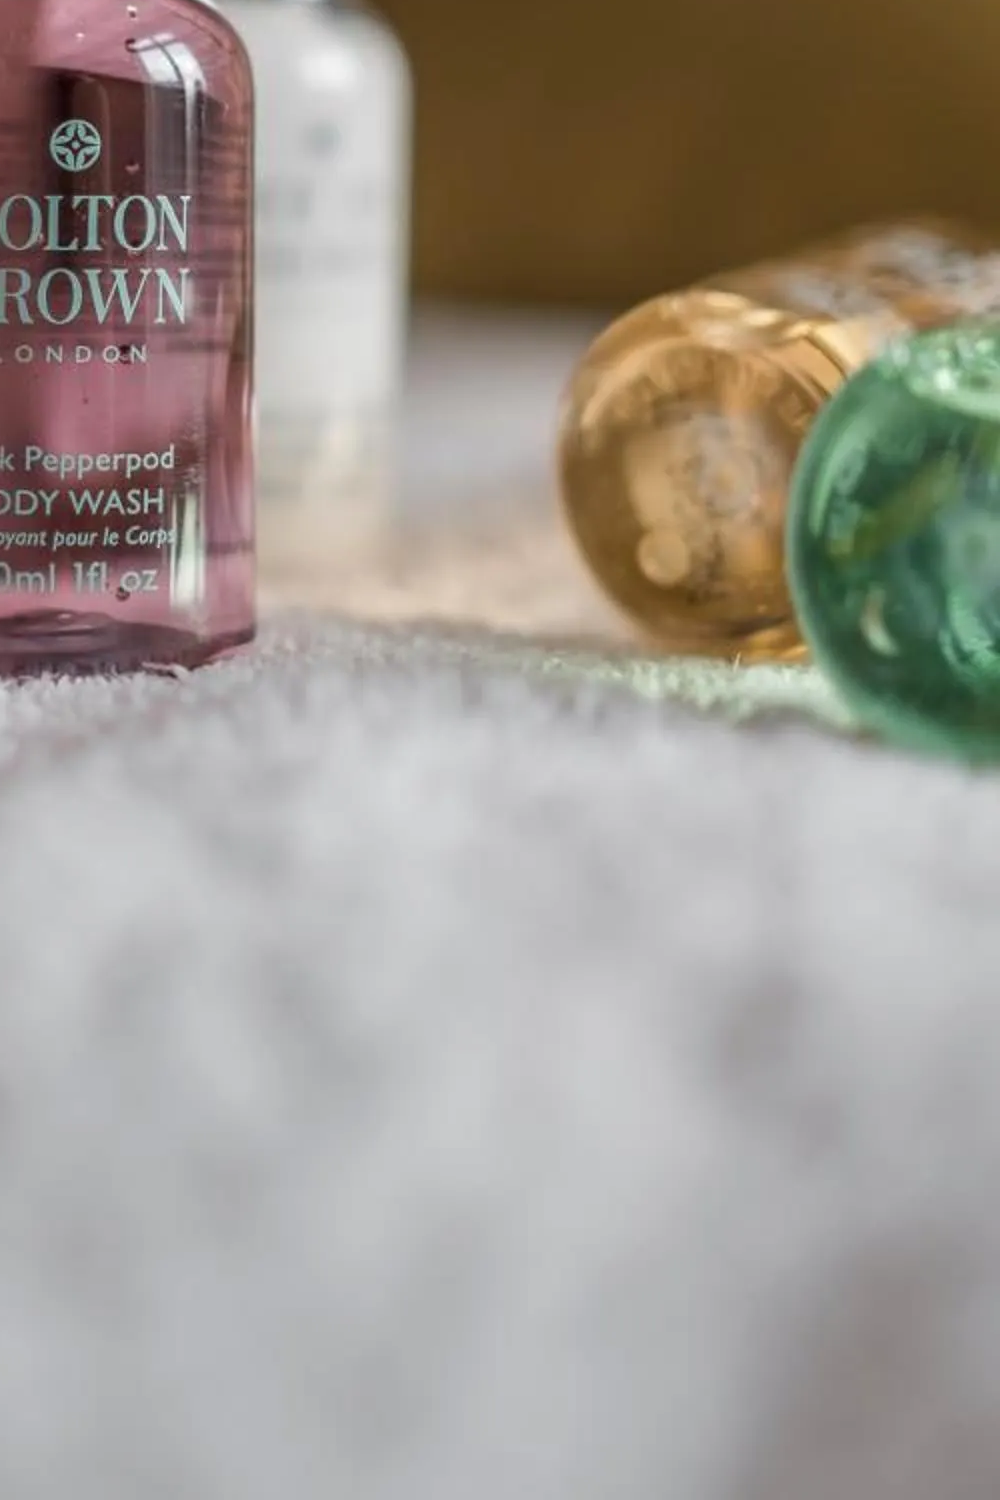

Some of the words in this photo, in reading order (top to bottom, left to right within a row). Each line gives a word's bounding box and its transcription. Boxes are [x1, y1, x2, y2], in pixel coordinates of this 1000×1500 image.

[24, 442, 175, 479] Pepperpod
[68, 487, 165, 516] WASH
[51, 529, 99, 552] pour
[103, 526, 120, 547] le
[124, 525, 177, 549] Corps
[119, 568, 160, 593] oz
